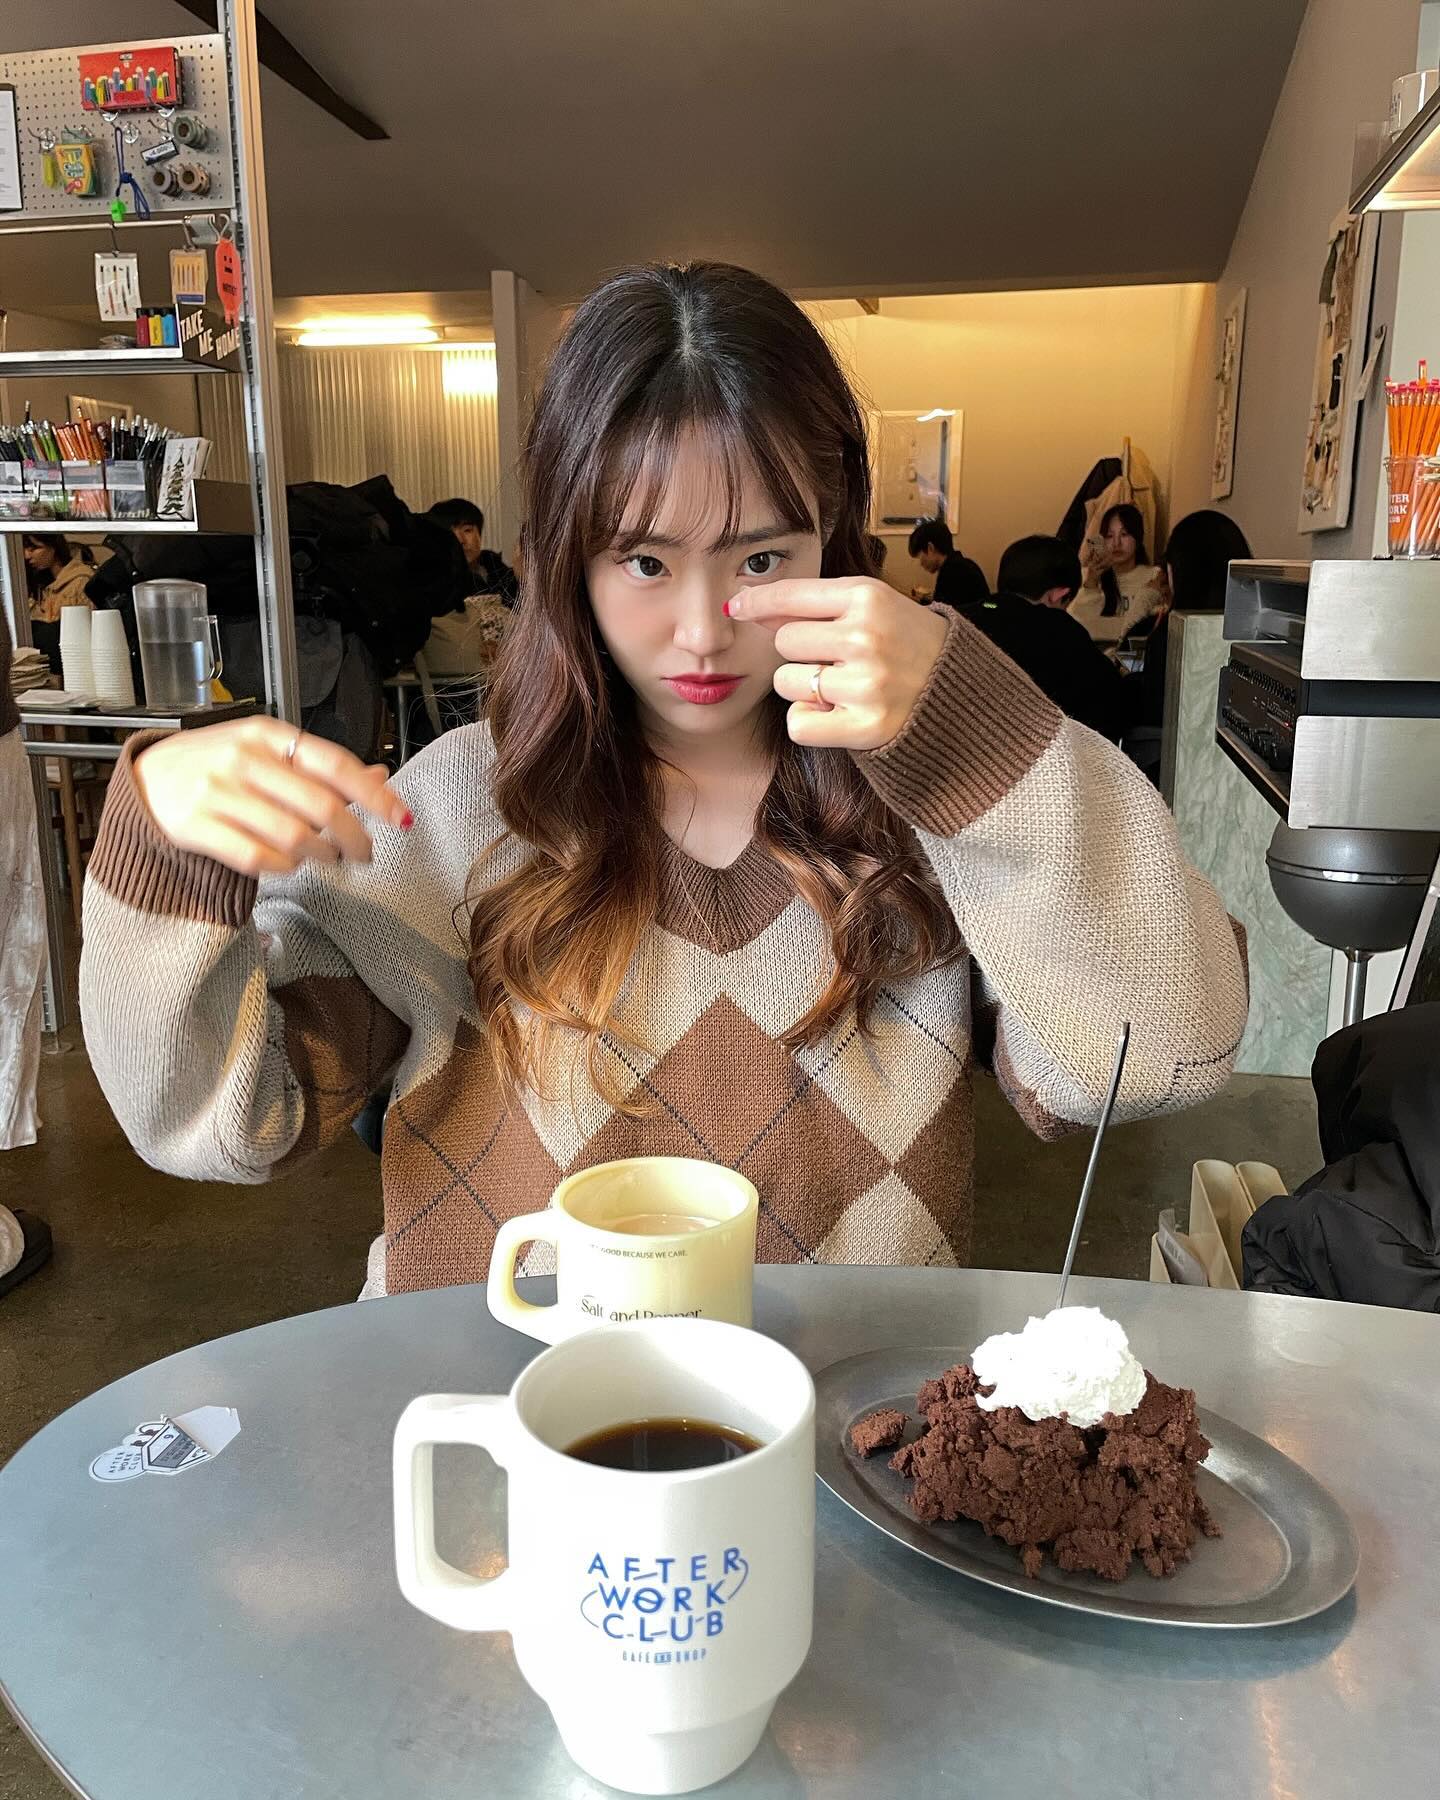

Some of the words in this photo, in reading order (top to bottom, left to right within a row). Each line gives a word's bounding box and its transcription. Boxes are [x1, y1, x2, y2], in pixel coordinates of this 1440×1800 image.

[180, 309, 204, 343] TAKE
[198, 328, 214, 357] ME
[216, 327, 240, 361] HOME
[1389, 505, 1407, 514] ORK
[1391, 494, 1409, 504] TER
[623, 1251, 653, 1259] BECAUSE
[587, 1547, 741, 1584] AFTER
[598, 1579, 727, 1614] WORK
[602, 1608, 724, 1642] CLUB
